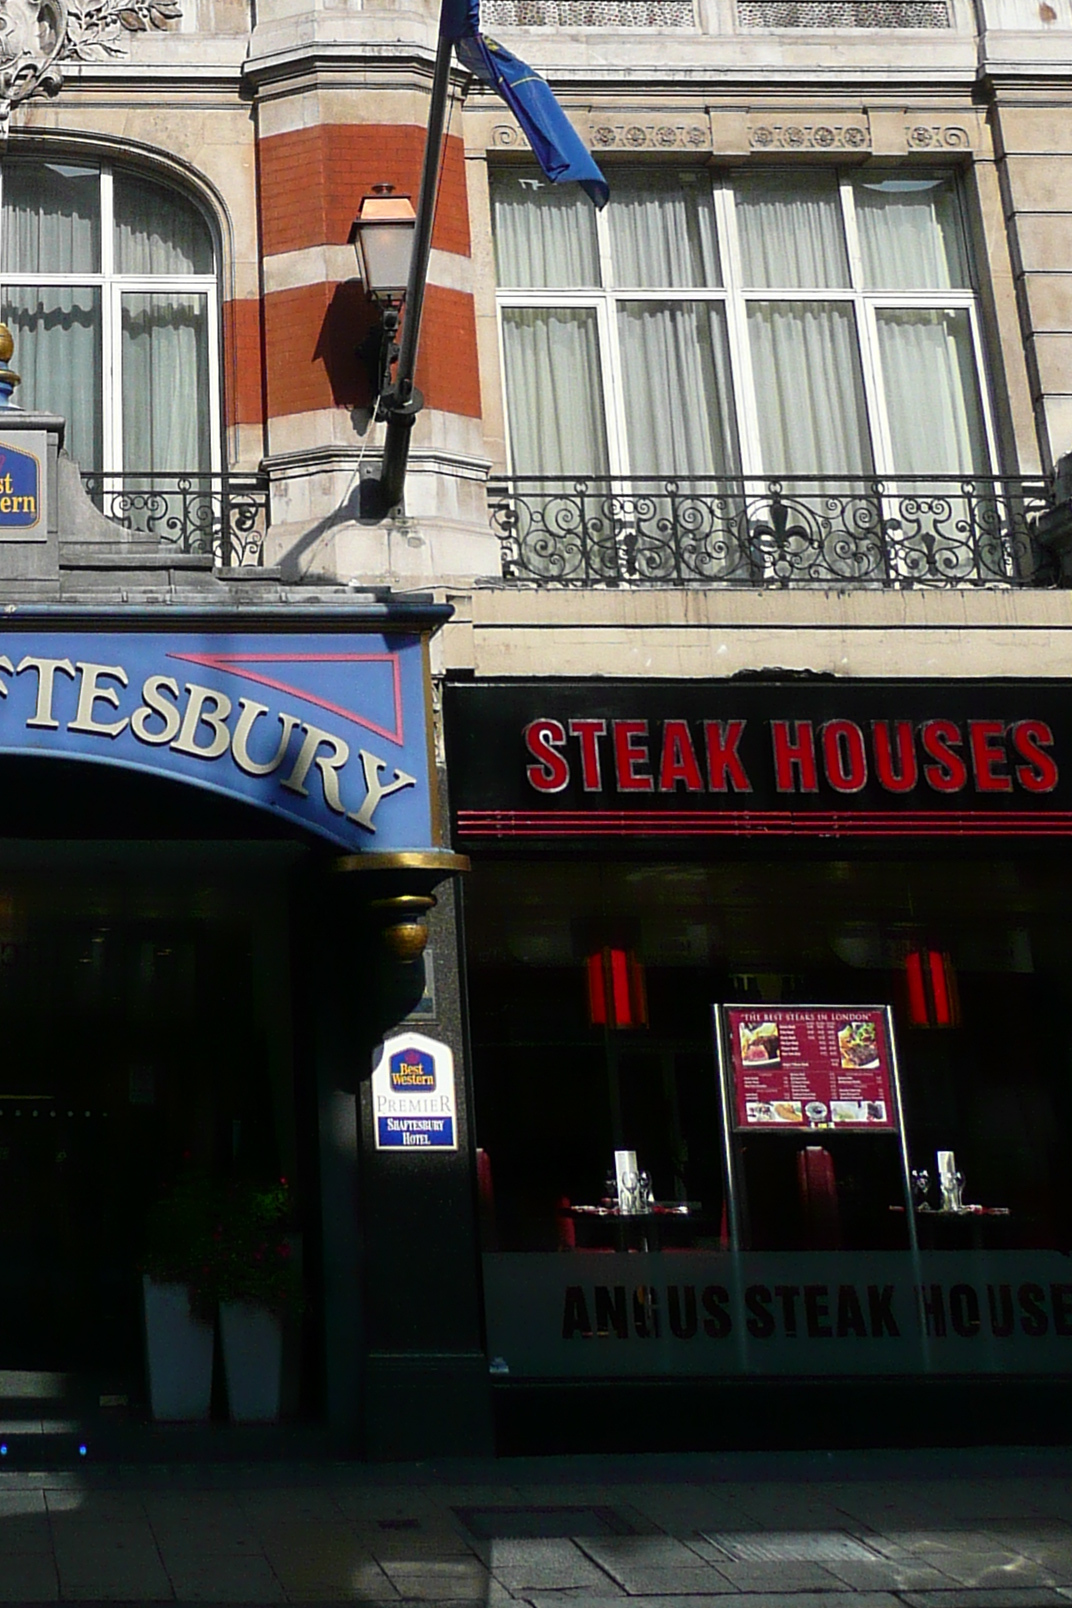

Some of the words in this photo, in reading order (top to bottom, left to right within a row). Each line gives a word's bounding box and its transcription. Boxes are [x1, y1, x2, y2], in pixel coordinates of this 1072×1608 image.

[523, 718, 754, 793] STEAK
[770, 718, 1060, 794] HOUSES
[764, 1012, 782, 1021] BEST
[786, 1012, 815, 1021] STEAKS
[400, 1063, 424, 1074] Best
[392, 1073, 434, 1084] Western
[377, 1095, 452, 1112] PREMIER
[387, 1118, 445, 1131] SHAFTESBURY
[403, 1132, 431, 1144] HOTEL
[745, 1285, 901, 1339] STEAK
